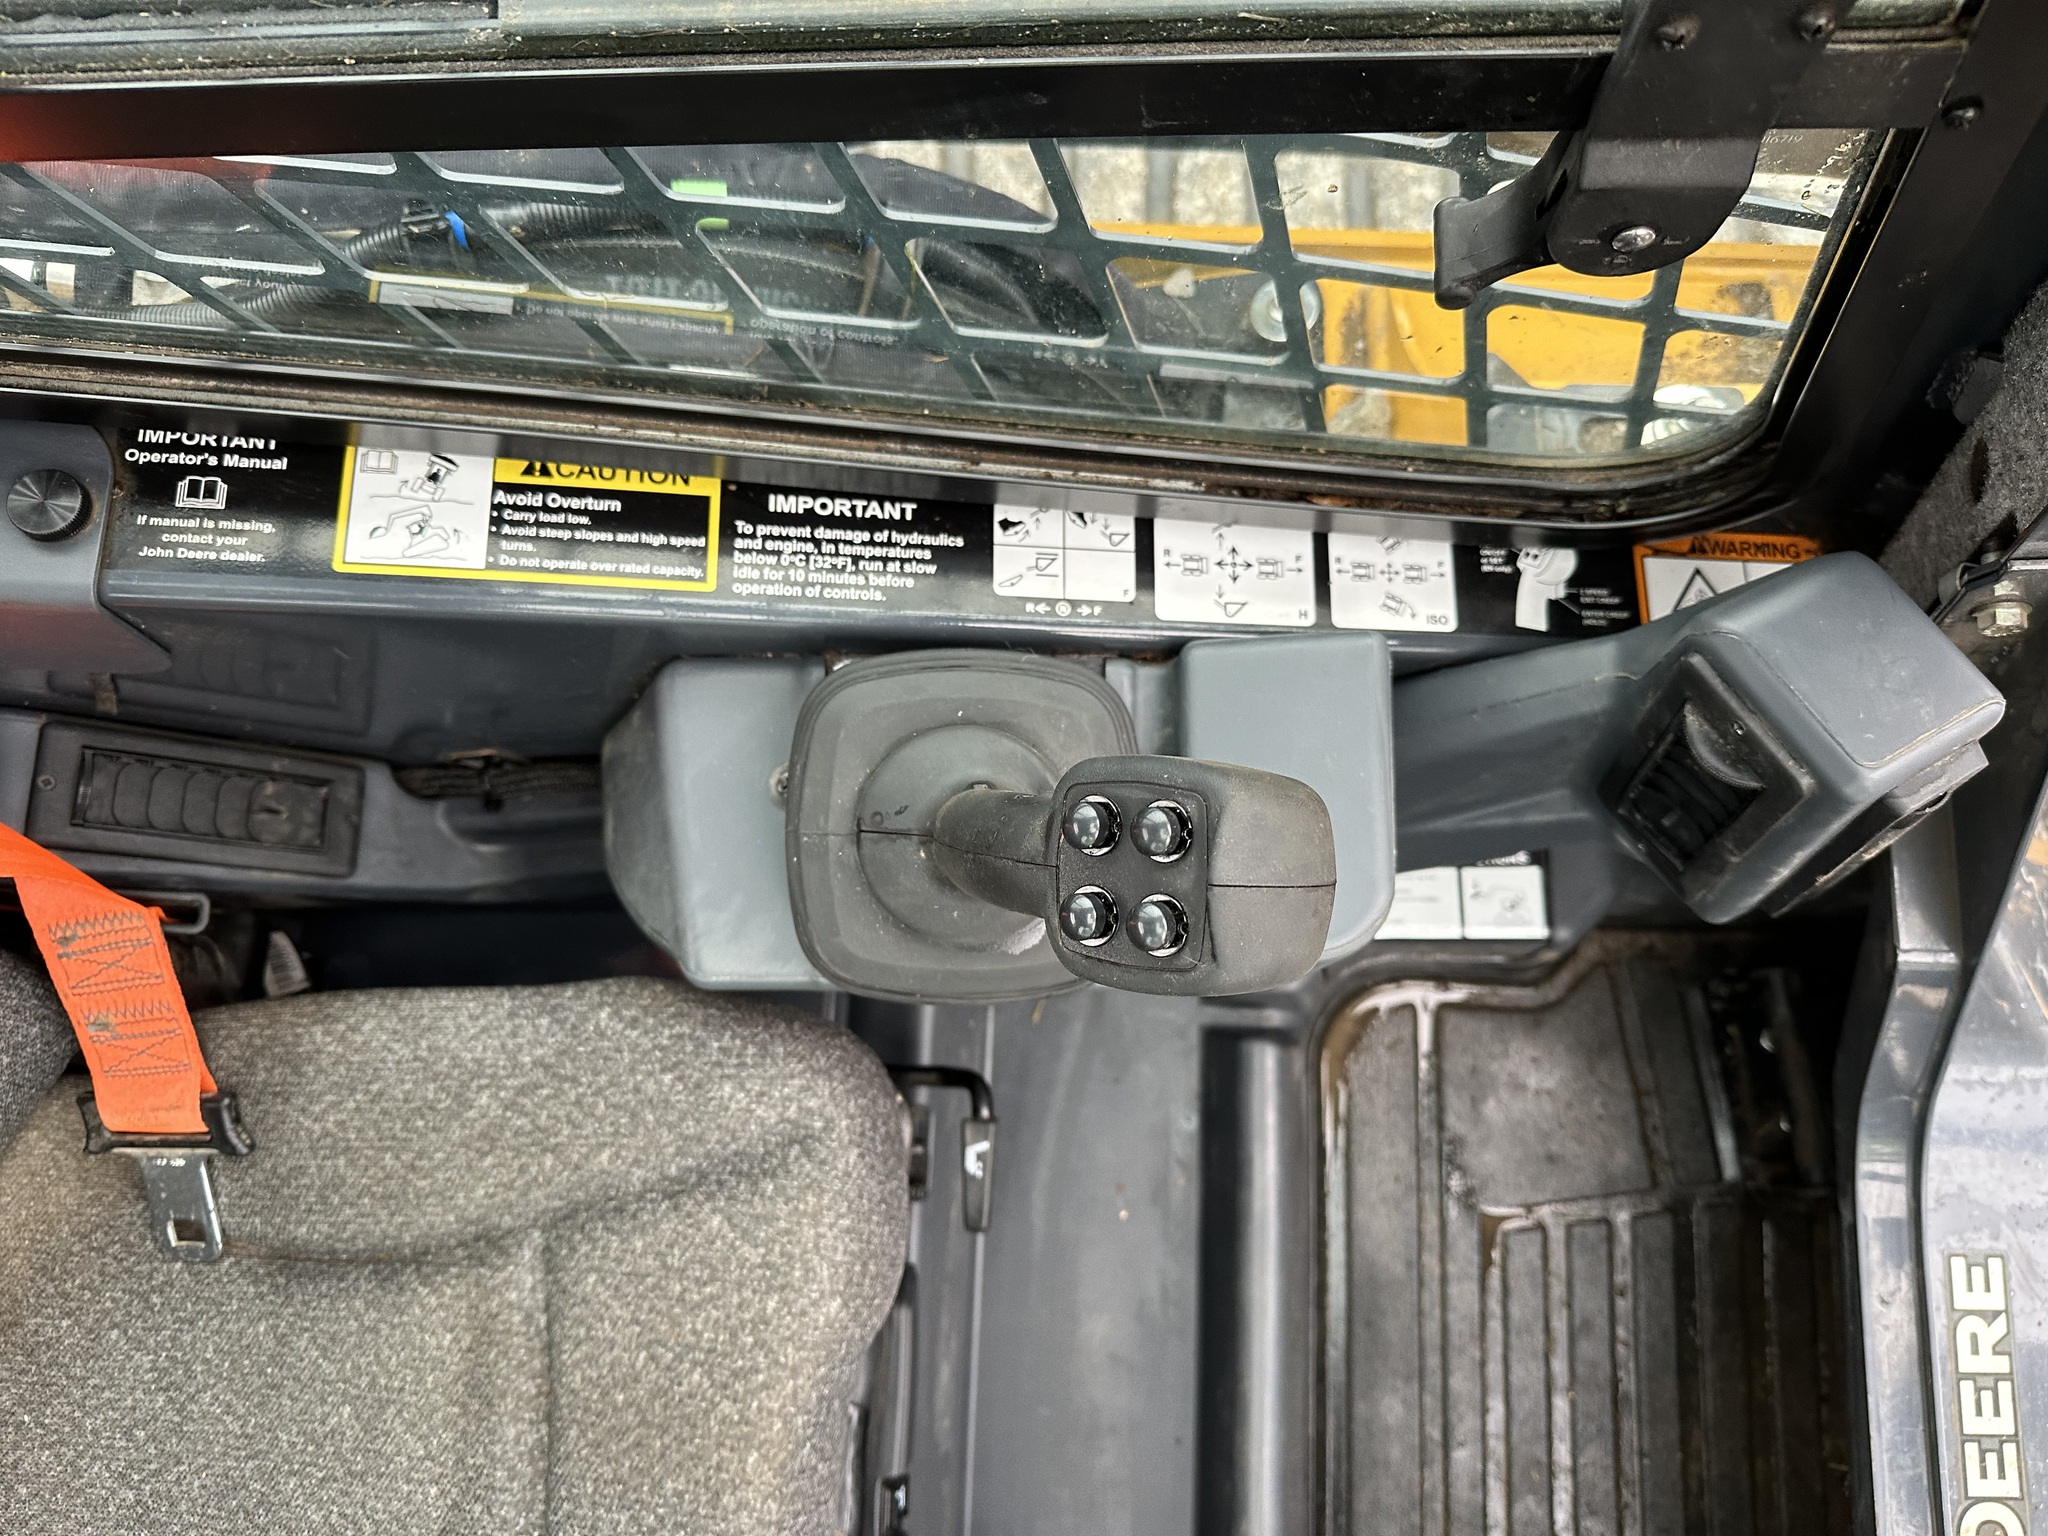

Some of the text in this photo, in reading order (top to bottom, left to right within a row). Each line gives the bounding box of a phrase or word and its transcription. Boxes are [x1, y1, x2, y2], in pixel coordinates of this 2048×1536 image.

[125, 449, 288, 470] Operator's Manual
[493, 489, 622, 512] Avoid Overturn
[768, 493, 918, 521] IMPORTANT
[137, 515, 276, 533] If manual is missing,
[502, 509, 592, 525] Carry load low.
[162, 533, 248, 546] contact your
[501, 525, 705, 548] Avoid steep slopes and high speed
[734, 520, 964, 547] To prevent damage of hydraulics
[138, 546, 266, 562] John Deere dealer.
[501, 540, 536, 552] turns.
[734, 537, 932, 560] and engine, in temperatures
[499, 554, 704, 579] Do not operate over rated capacity.
[734, 551, 777, 565] below
[858, 559, 883, 572] run
[886, 559, 901, 572] at
[903, 560, 937, 575] slow
[733, 566, 914, 588] idle for 10 minutes before
[732, 581, 887, 601] operation of controls.
[1025, 602, 1035, 613] R
[1093, 605, 1102, 616] F
[1299, 609, 1307, 619] H
[1426, 614, 1448, 625] ISO
